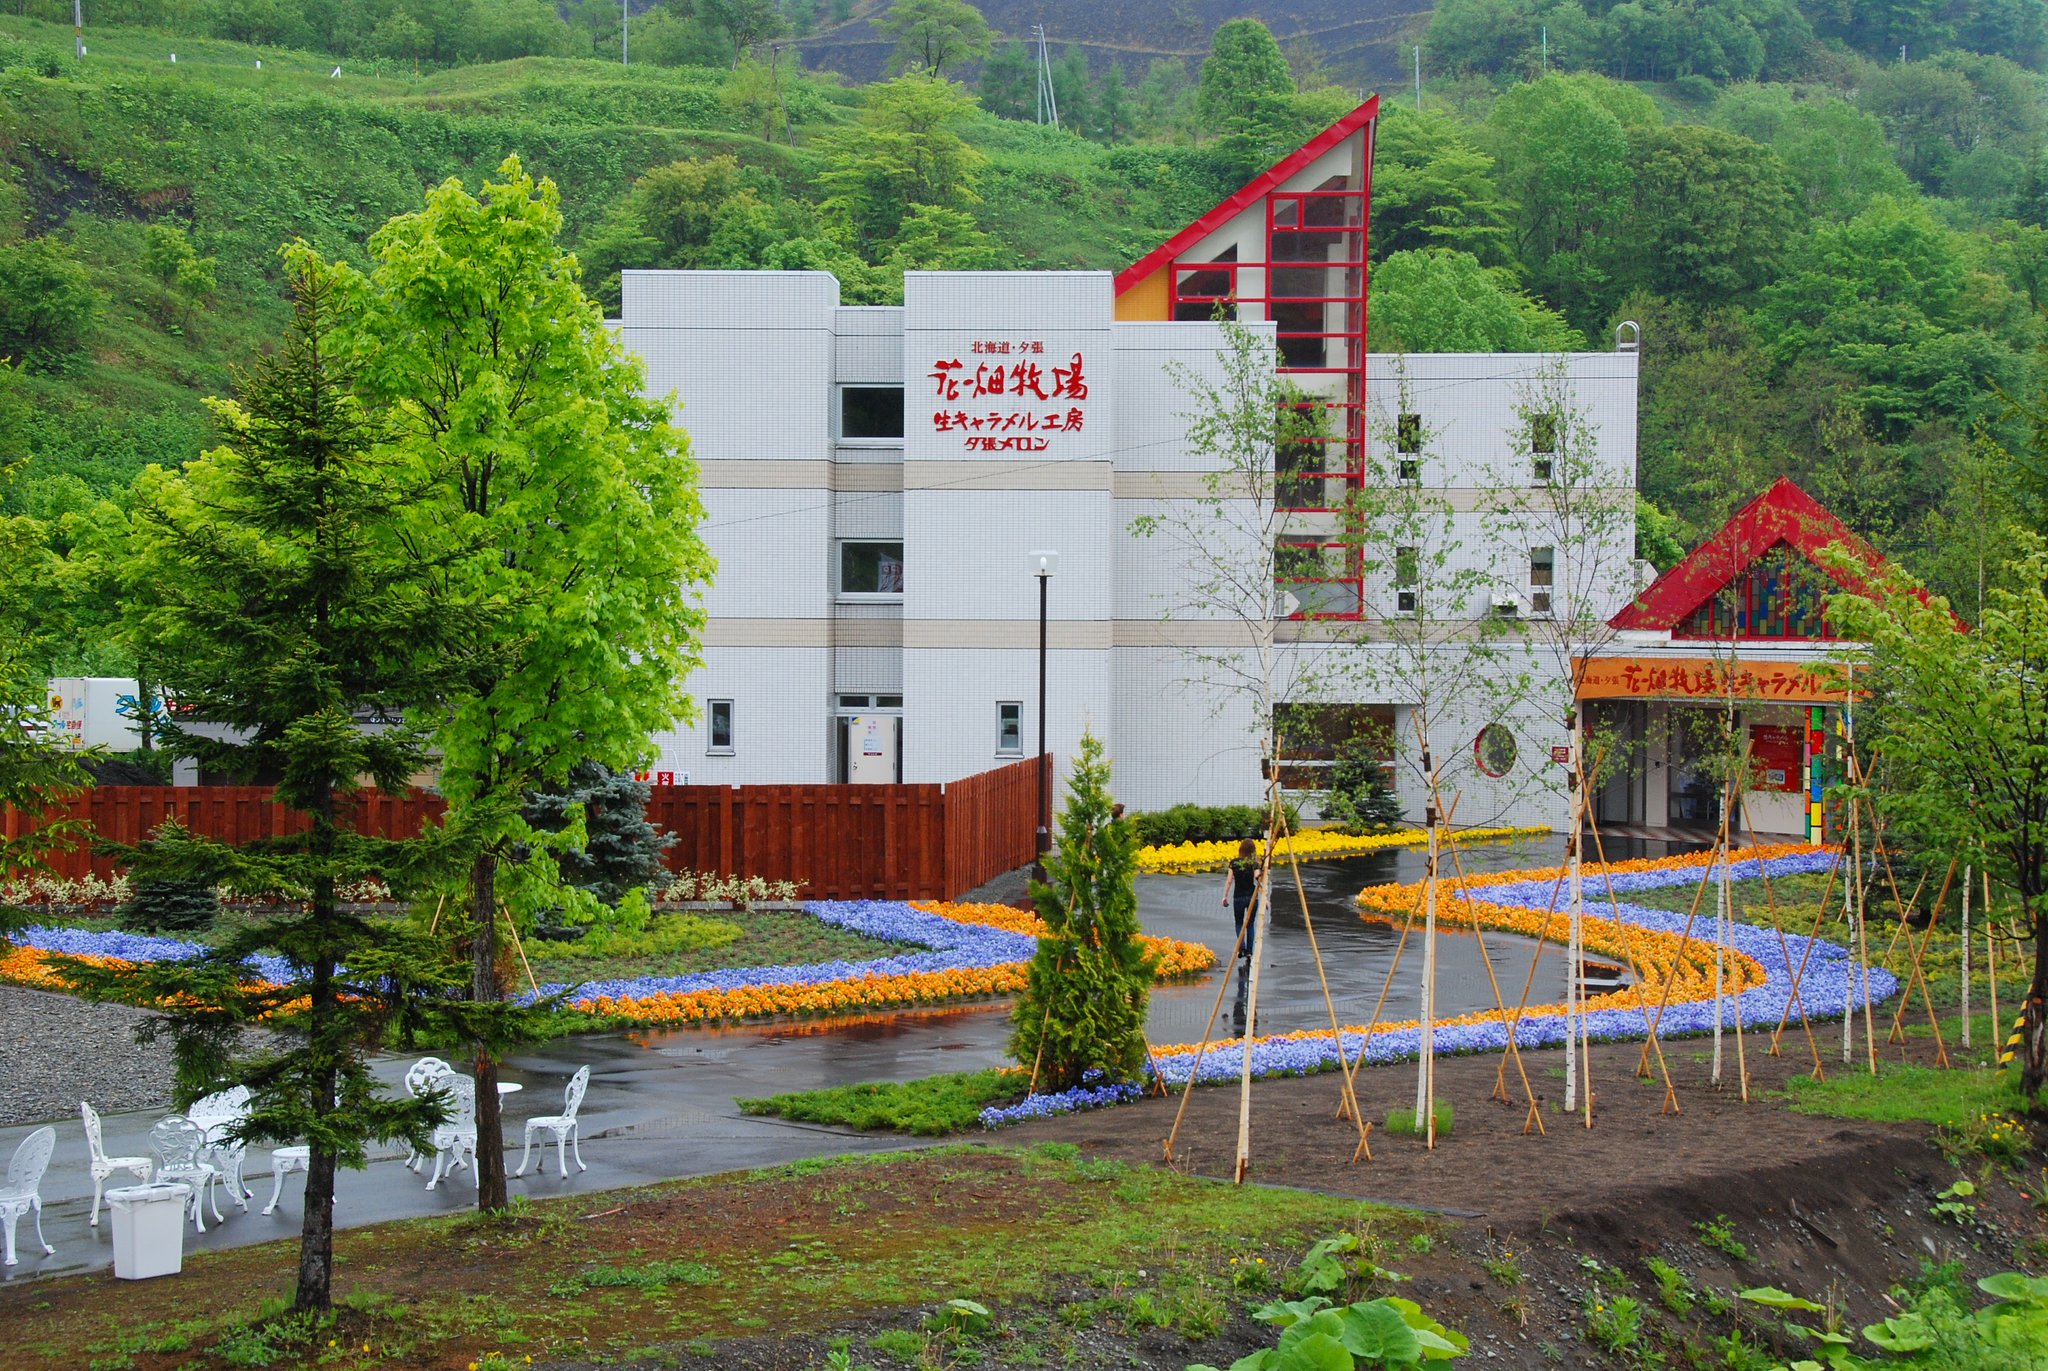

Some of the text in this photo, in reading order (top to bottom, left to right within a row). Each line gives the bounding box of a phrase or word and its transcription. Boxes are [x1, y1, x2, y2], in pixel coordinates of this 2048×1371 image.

[971, 341, 1044, 354] 北海道・夕張
[928, 352, 1088, 401] 花畑牧場
[933, 407, 1084, 432] 生キャラメル工房
[964, 436, 1050, 452] 夕張メロン
